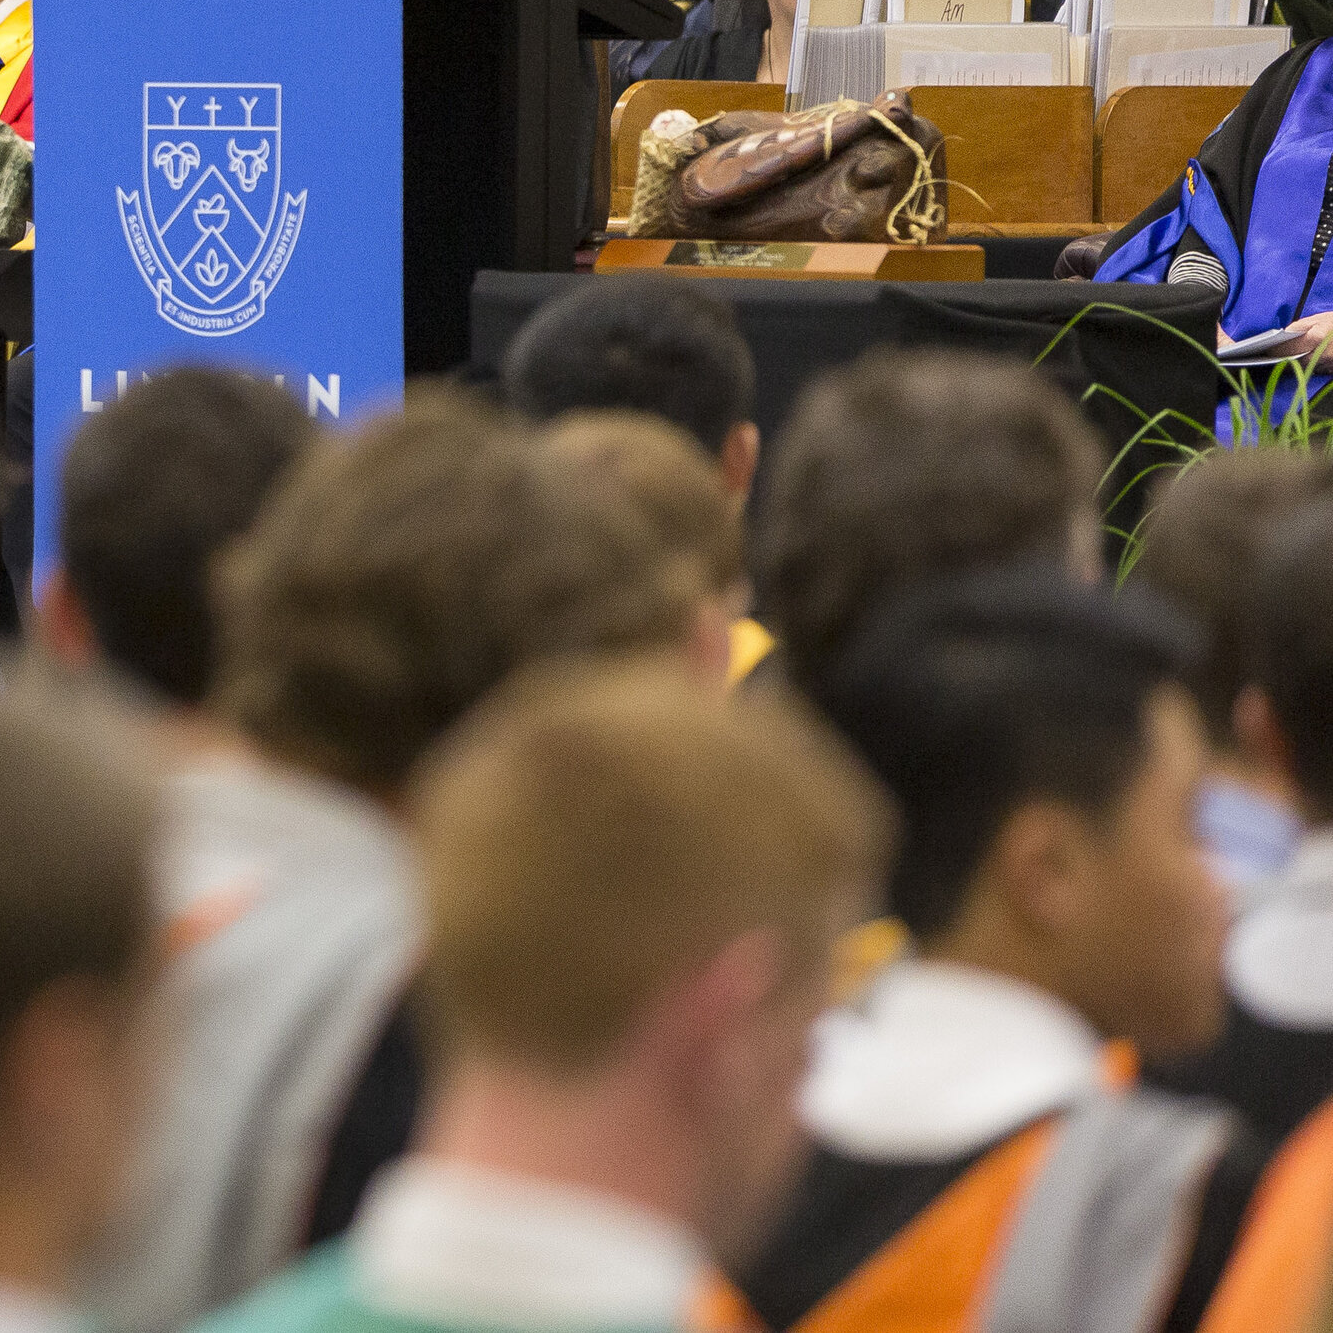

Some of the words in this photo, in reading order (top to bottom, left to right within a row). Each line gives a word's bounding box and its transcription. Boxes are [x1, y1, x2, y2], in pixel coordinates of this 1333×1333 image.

[940, 0, 965, 22] AM
[128, 214, 157, 276] SCIENTIA
[264, 212, 298, 279] PROBITATE
